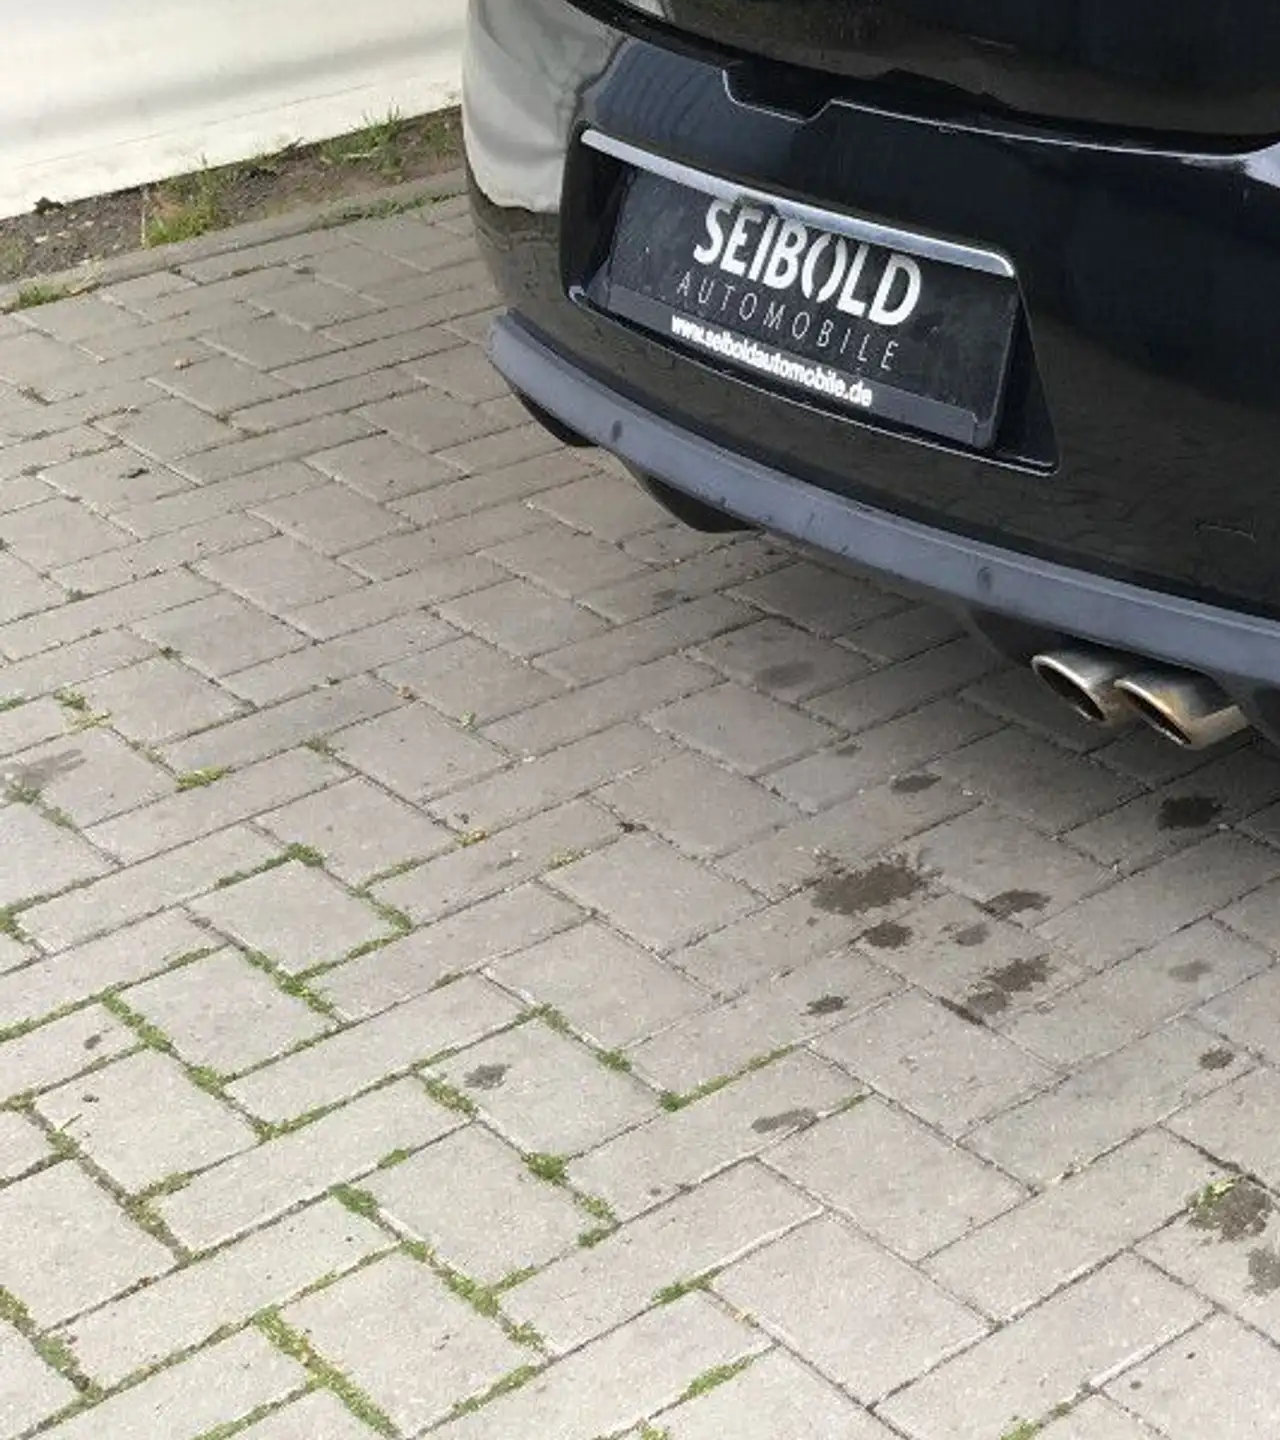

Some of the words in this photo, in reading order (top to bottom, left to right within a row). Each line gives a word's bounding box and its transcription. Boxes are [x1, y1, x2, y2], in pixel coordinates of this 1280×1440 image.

[693, 197, 922, 326] SEIBOLD
[671, 314, 873, 407] www.seiboldautomobile.de
[676, 271, 899, 372] AUTOMOBILE
